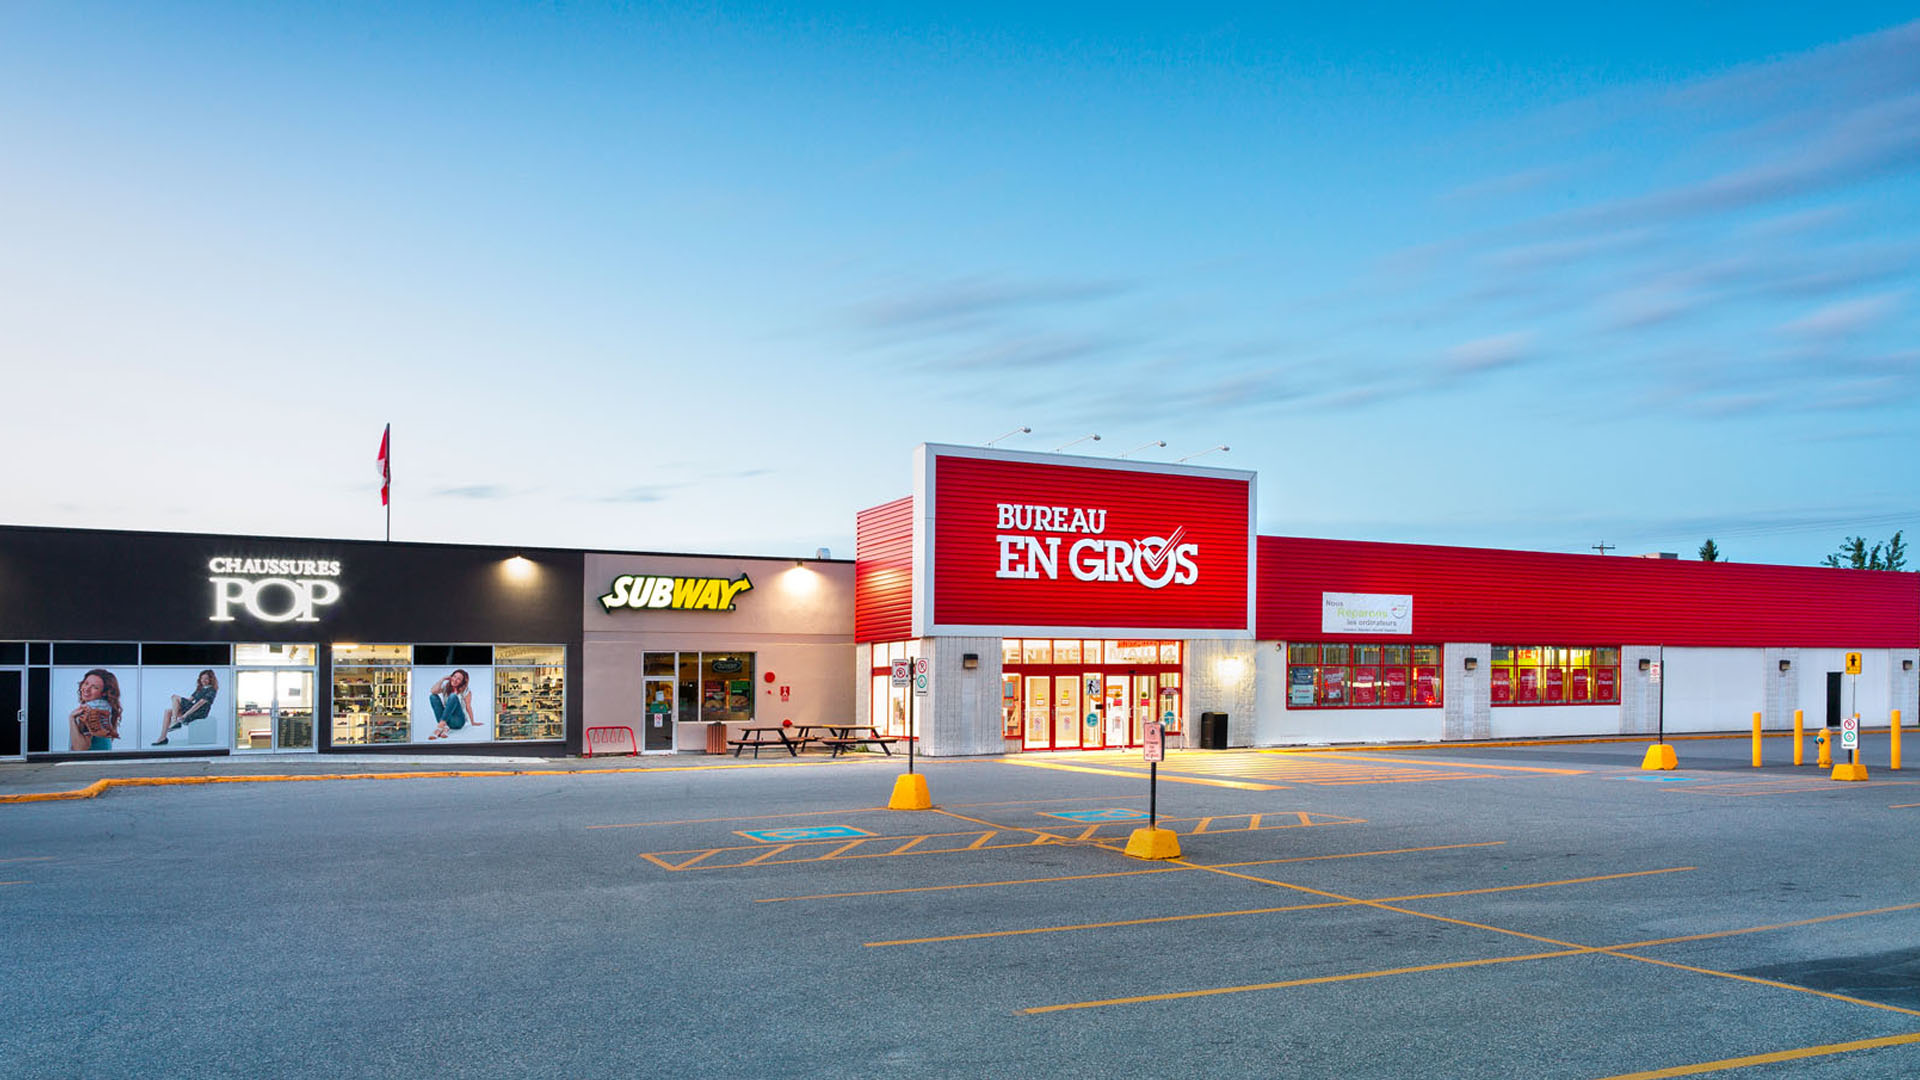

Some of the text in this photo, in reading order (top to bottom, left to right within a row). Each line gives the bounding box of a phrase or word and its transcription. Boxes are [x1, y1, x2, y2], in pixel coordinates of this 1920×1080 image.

[996, 503, 1107, 534] BUREAU
[208, 556, 341, 576] CHAUSSURES
[996, 534, 1199, 589] EN GROS
[208, 576, 341, 622] POP
[602, 574, 752, 610] SUBWAY
